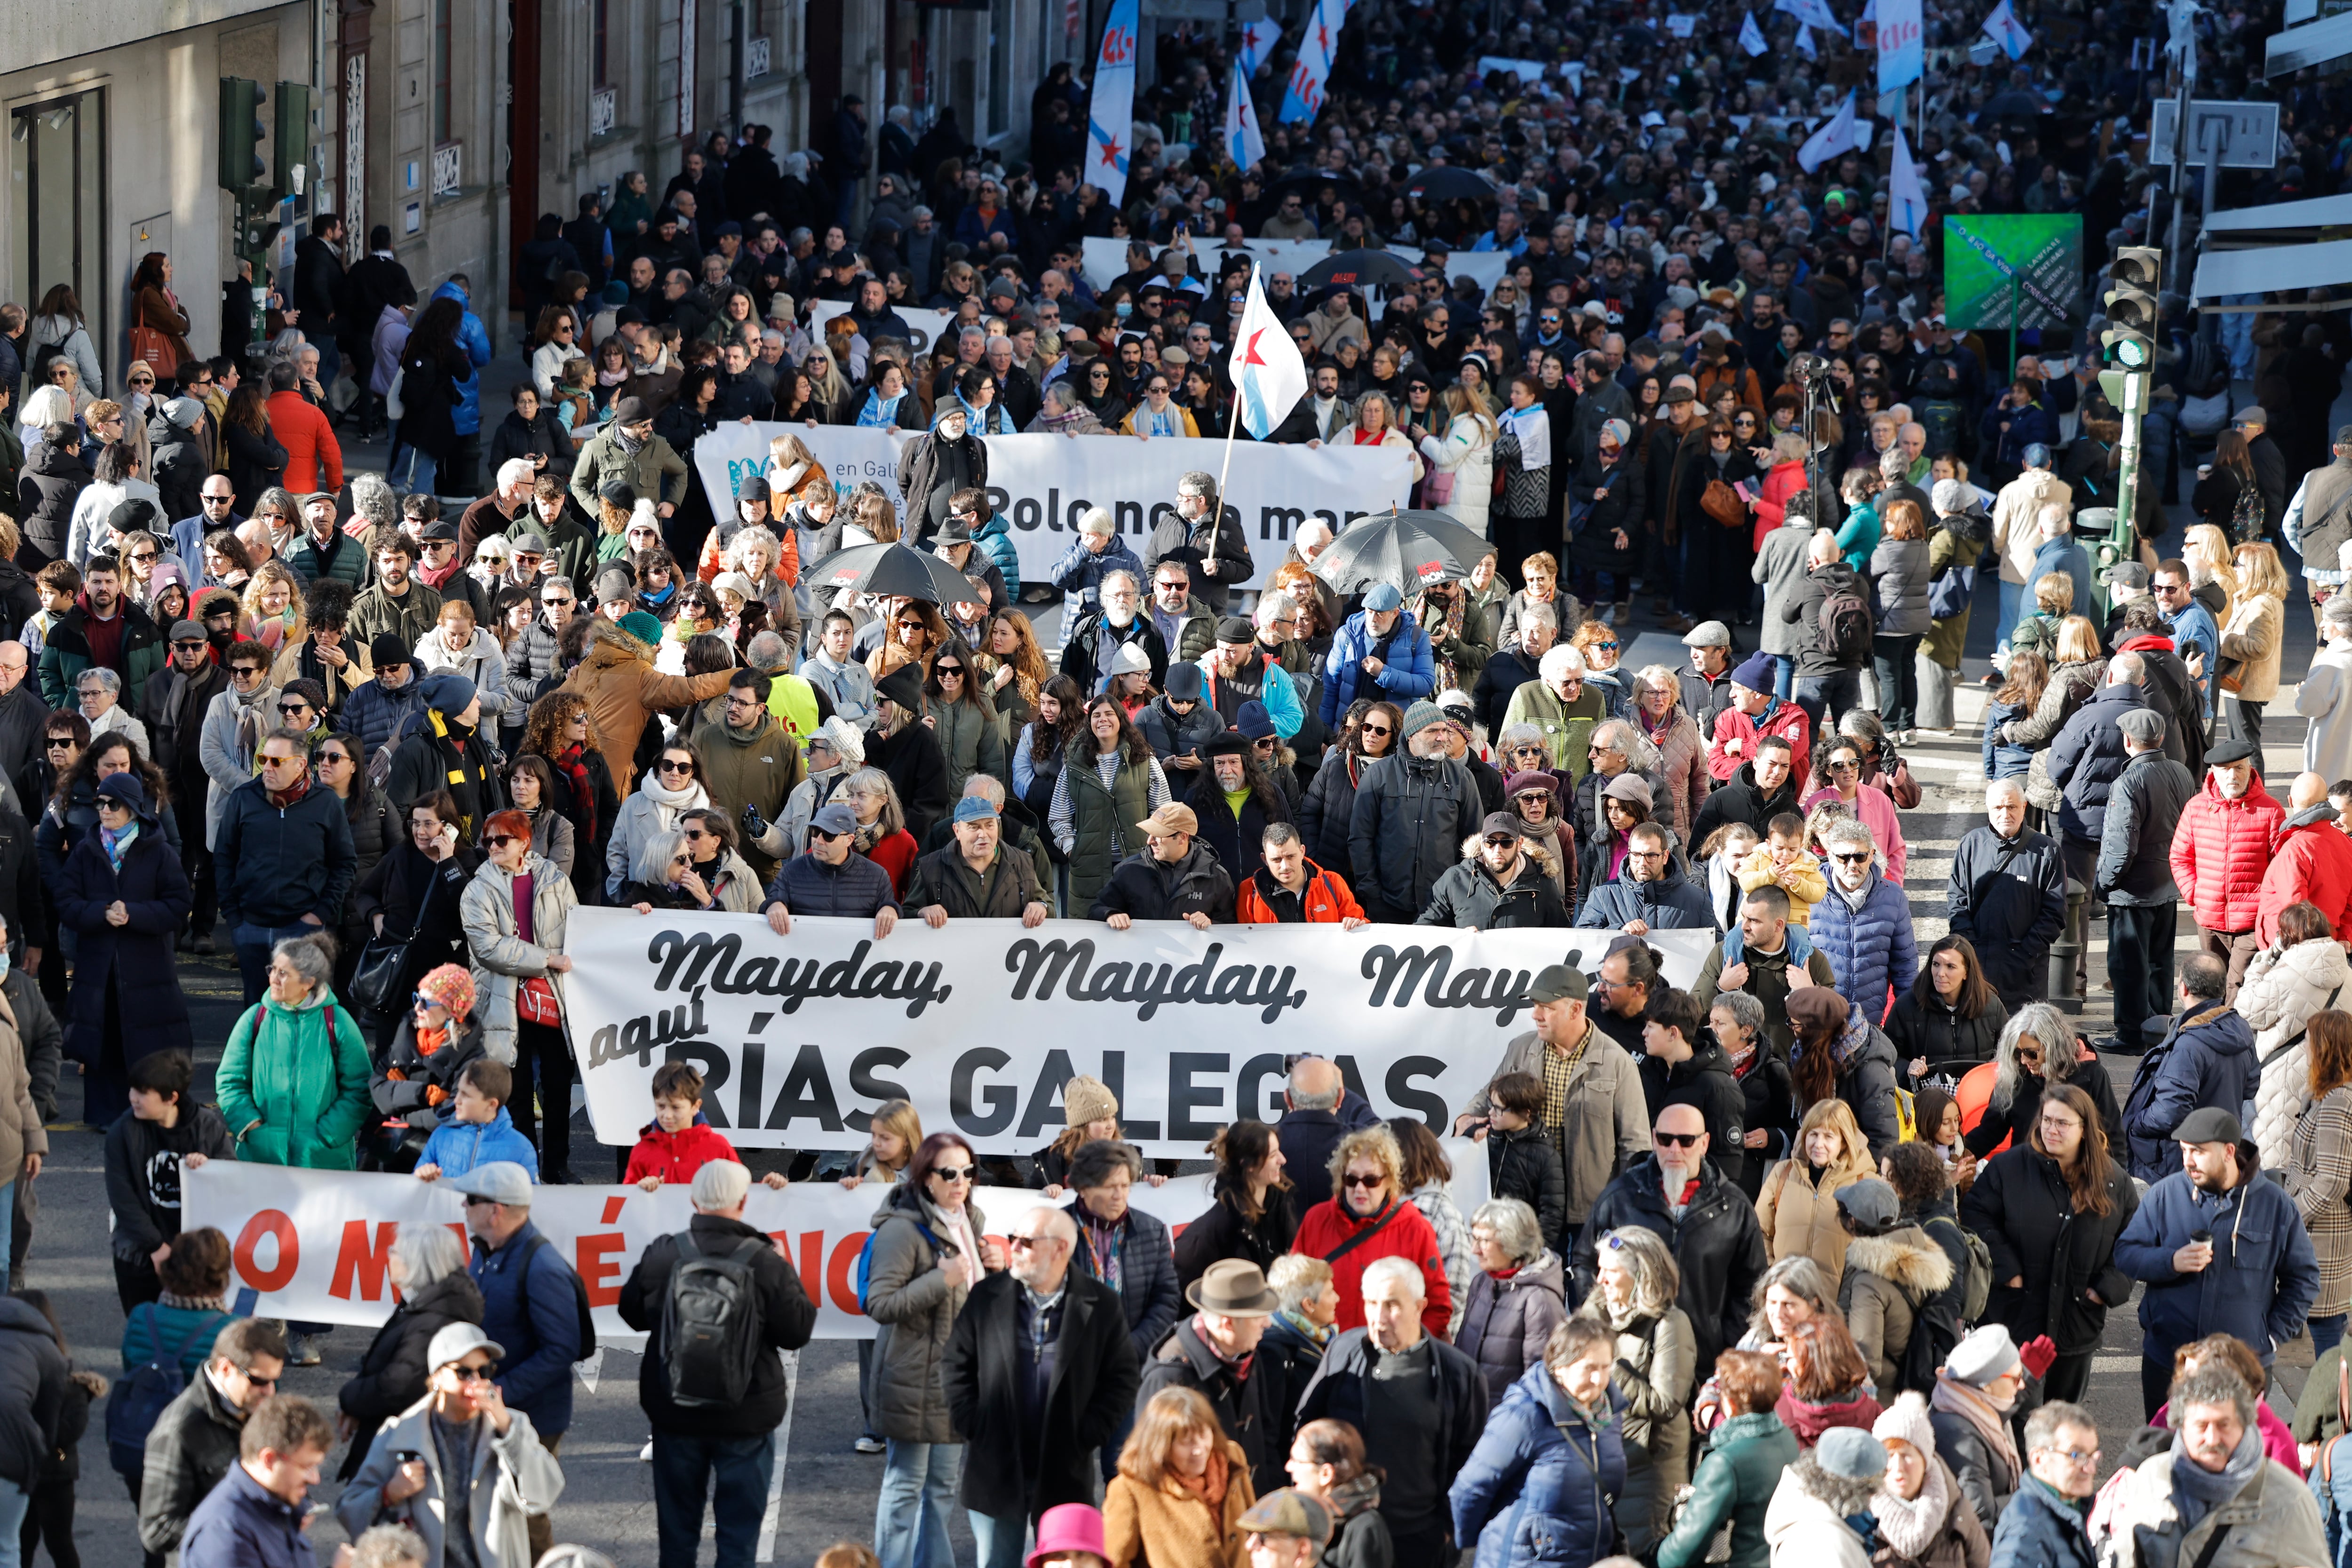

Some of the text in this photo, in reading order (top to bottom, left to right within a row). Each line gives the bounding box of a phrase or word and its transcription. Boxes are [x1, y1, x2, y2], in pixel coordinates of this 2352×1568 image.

[2026, 237, 2061, 269] LAWFARE
[836, 461, 897, 478] en Gali
[1420, 570, 1446, 584] NON
[647, 930, 953, 1020] Mayday,
[1005, 938, 1307, 1025] Mayday,
[588, 984, 709, 1068] aquí
[665, 1012, 1448, 1142] RÍAS GALEGS
[233, 1208, 300, 1292] O
[575, 1196, 627, 1308] É
